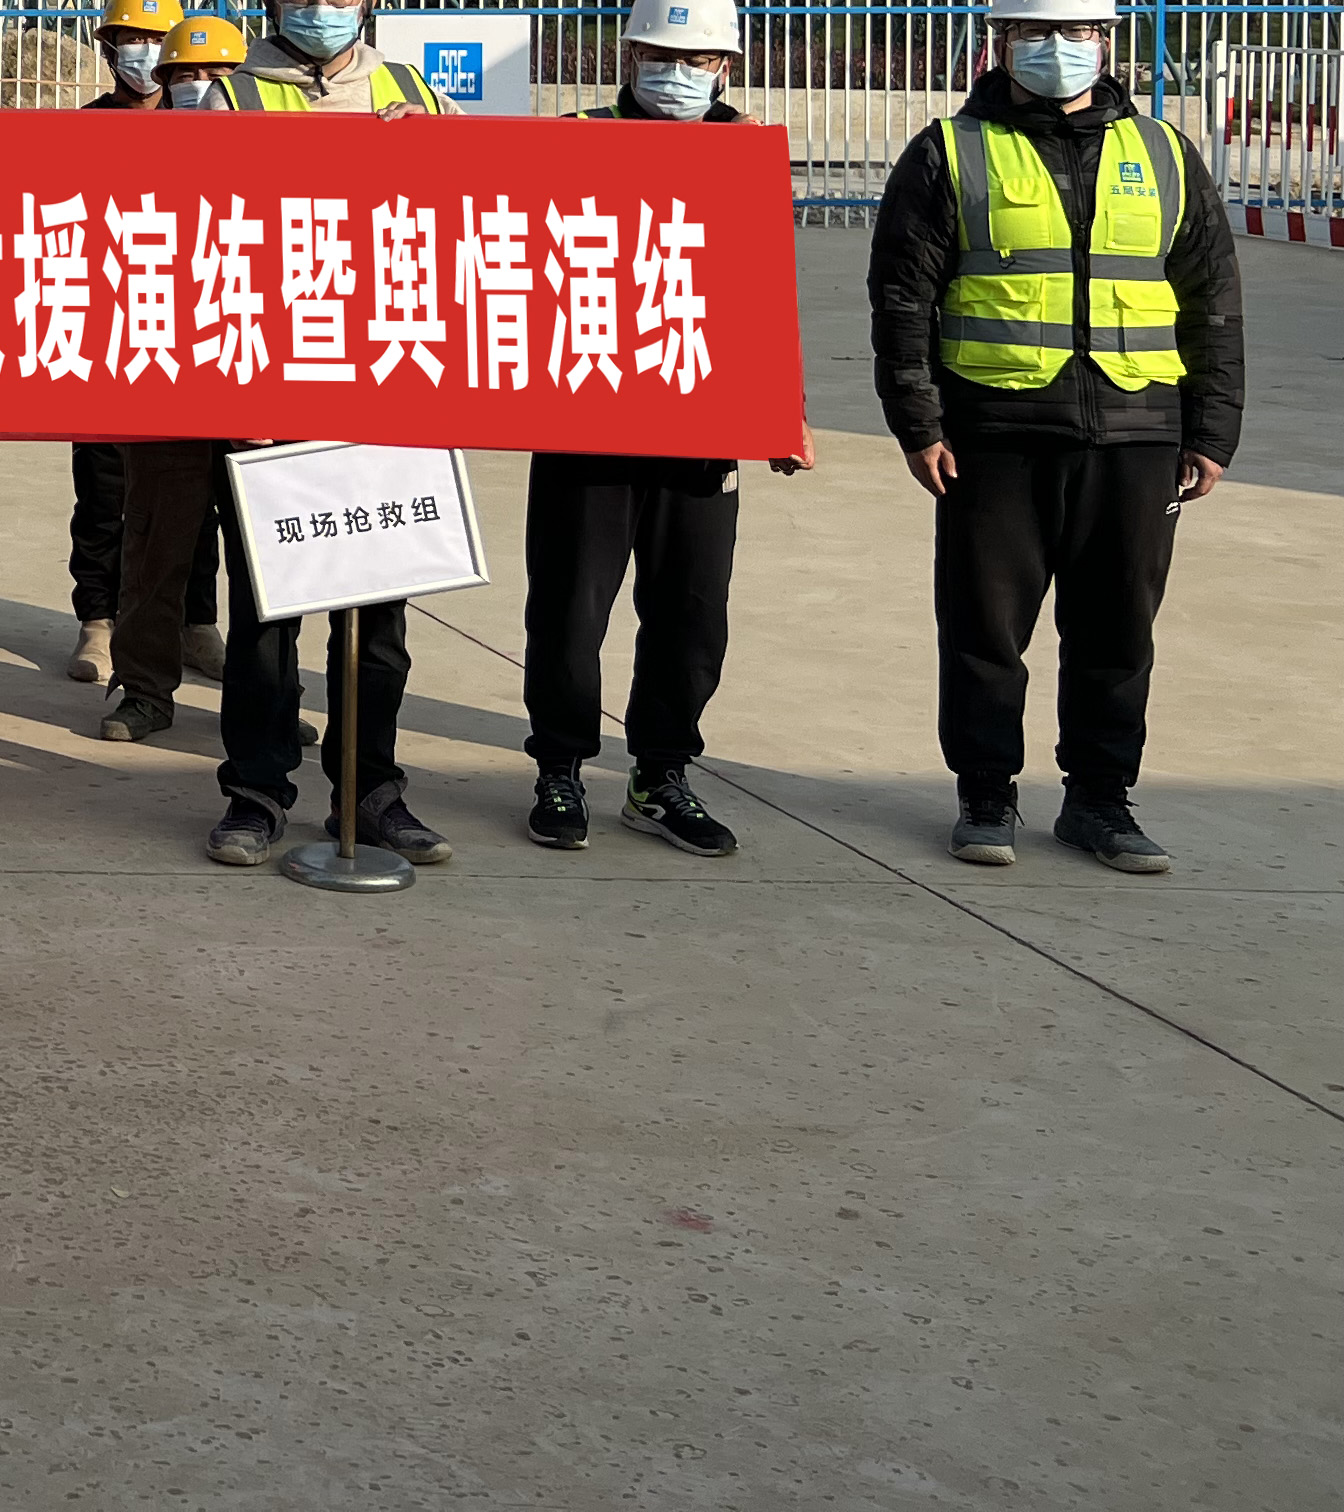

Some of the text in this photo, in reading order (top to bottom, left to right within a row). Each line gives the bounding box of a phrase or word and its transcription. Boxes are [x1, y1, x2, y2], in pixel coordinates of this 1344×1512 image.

[274, 495, 441, 544] 现场抢救组
